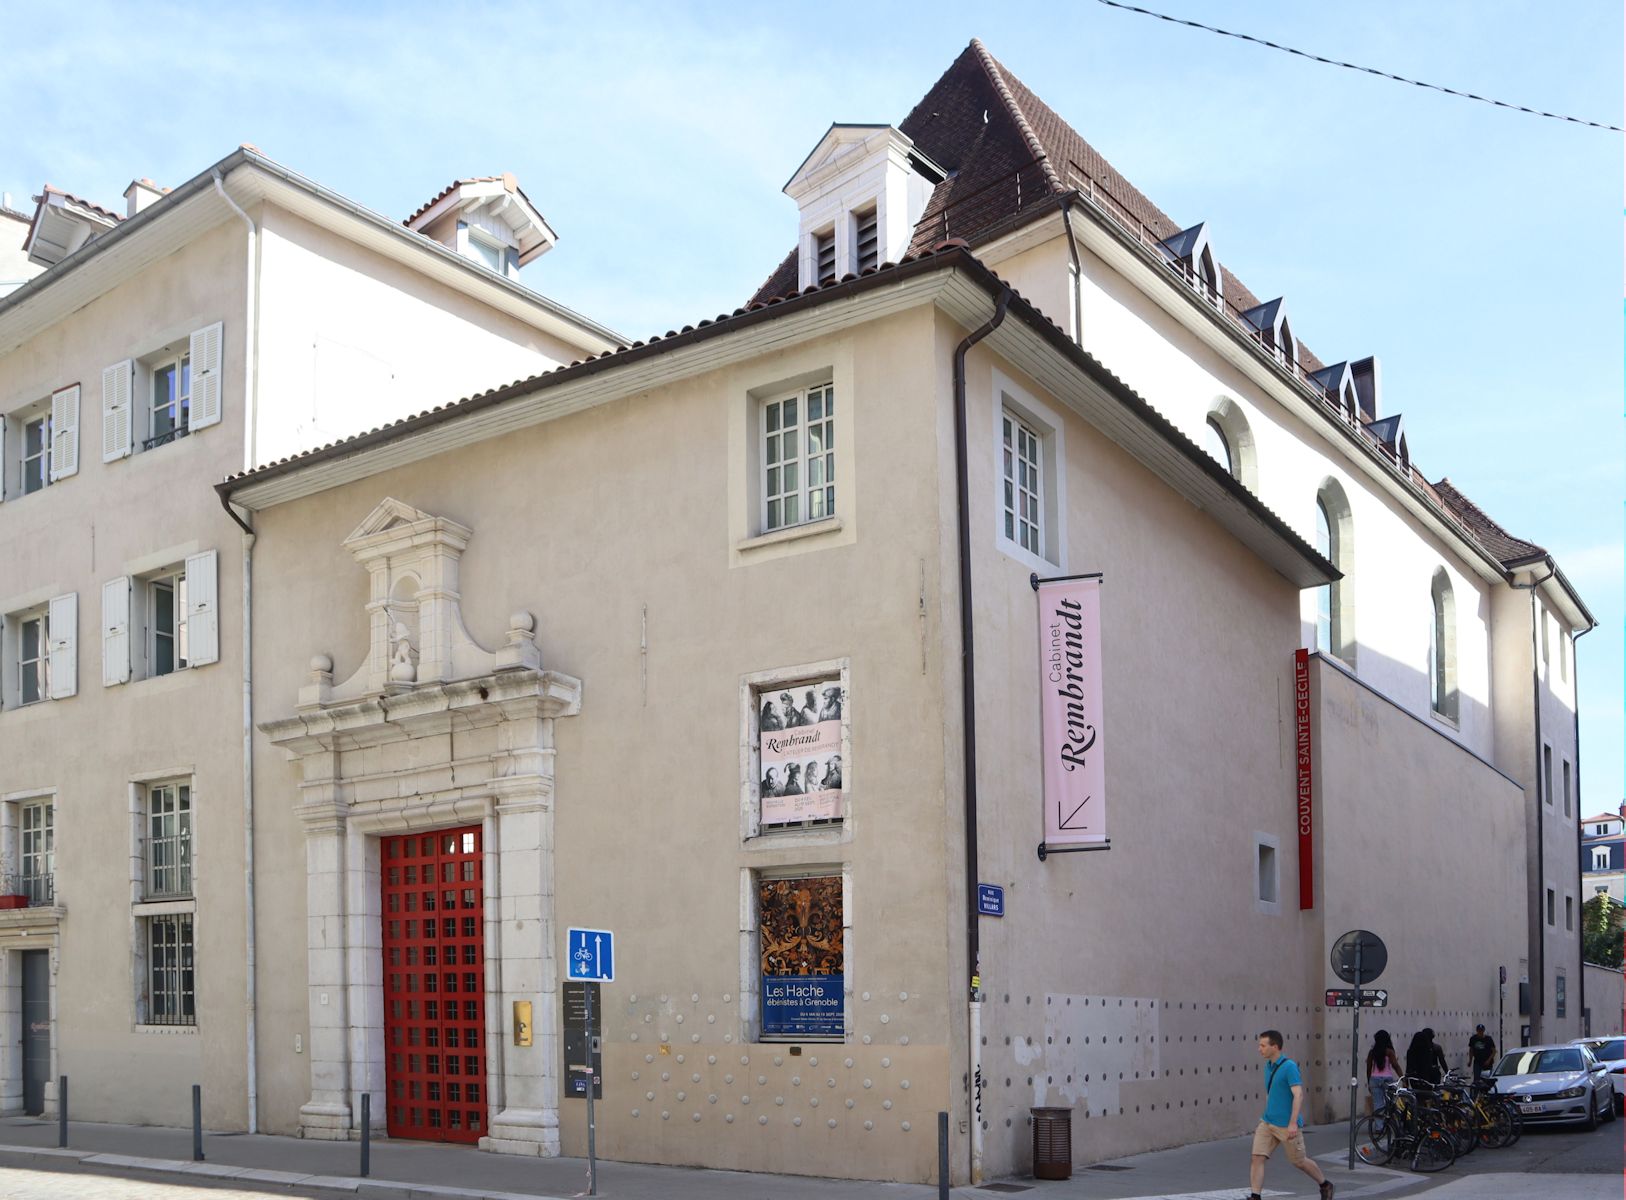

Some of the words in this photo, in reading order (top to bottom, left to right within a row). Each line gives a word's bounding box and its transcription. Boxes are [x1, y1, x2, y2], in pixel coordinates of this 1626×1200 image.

[1049, 623, 1061, 682] Cabinet
[1056, 598, 1096, 772] Rembrandt
[766, 730, 820, 753] Rembrandt
[1300, 769, 1312, 835] COUVENT
[766, 985, 784, 997] Les
[786, 984, 824, 997] Hache
[804, 998, 839, 1006] Grenoble
